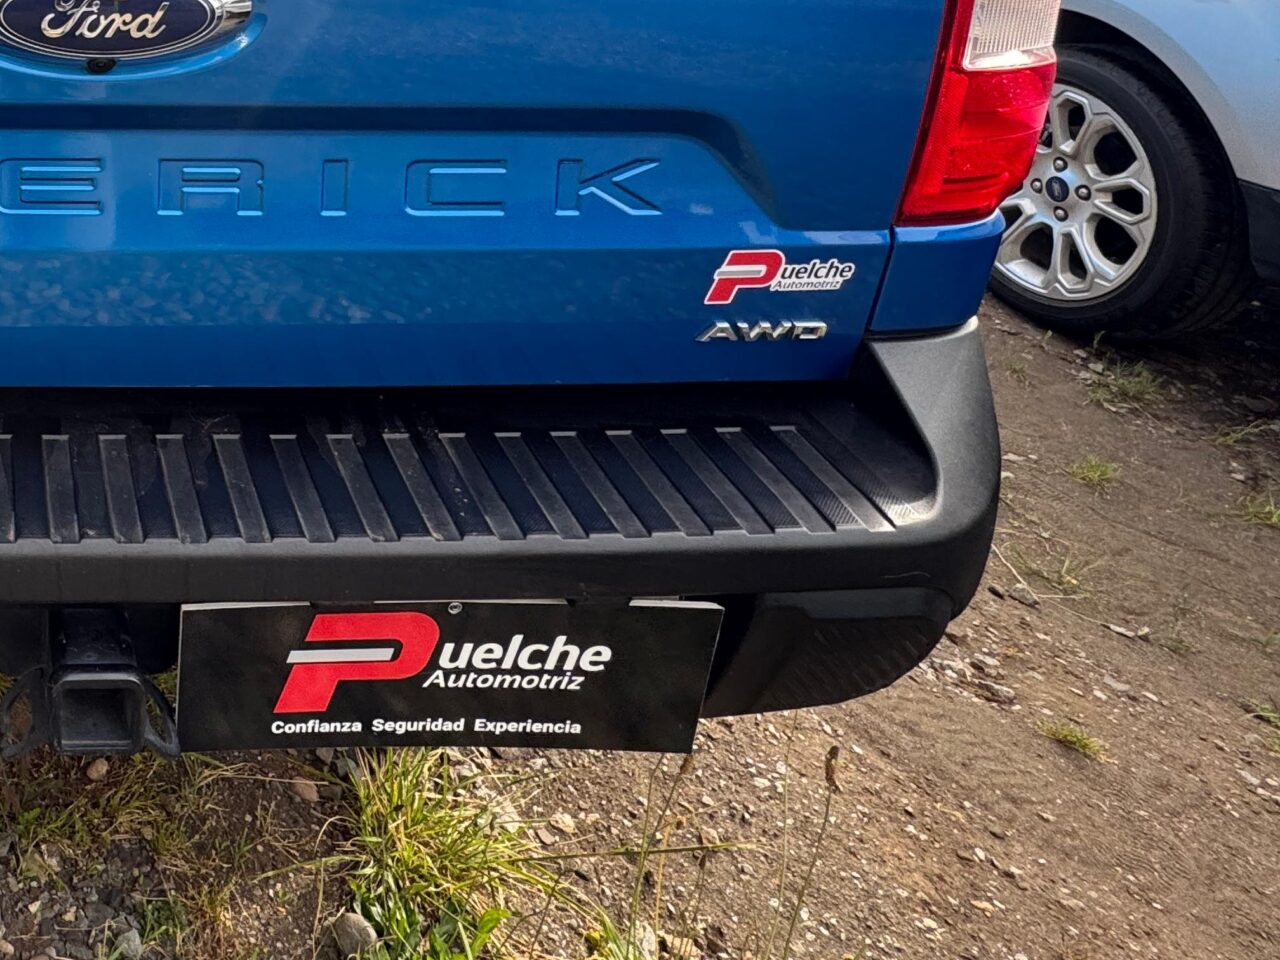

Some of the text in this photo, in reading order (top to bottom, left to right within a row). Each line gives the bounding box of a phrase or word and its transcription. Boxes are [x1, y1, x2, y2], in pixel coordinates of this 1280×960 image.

[705, 249, 855, 304] Puelche
[772, 280, 841, 290] Automotriz
[695, 320, 828, 342] AWD
[273, 610, 612, 713] Puelche
[423, 670, 587, 691] Automotriz
[271, 717, 582, 735] Confianza Seguridad Experiencia
